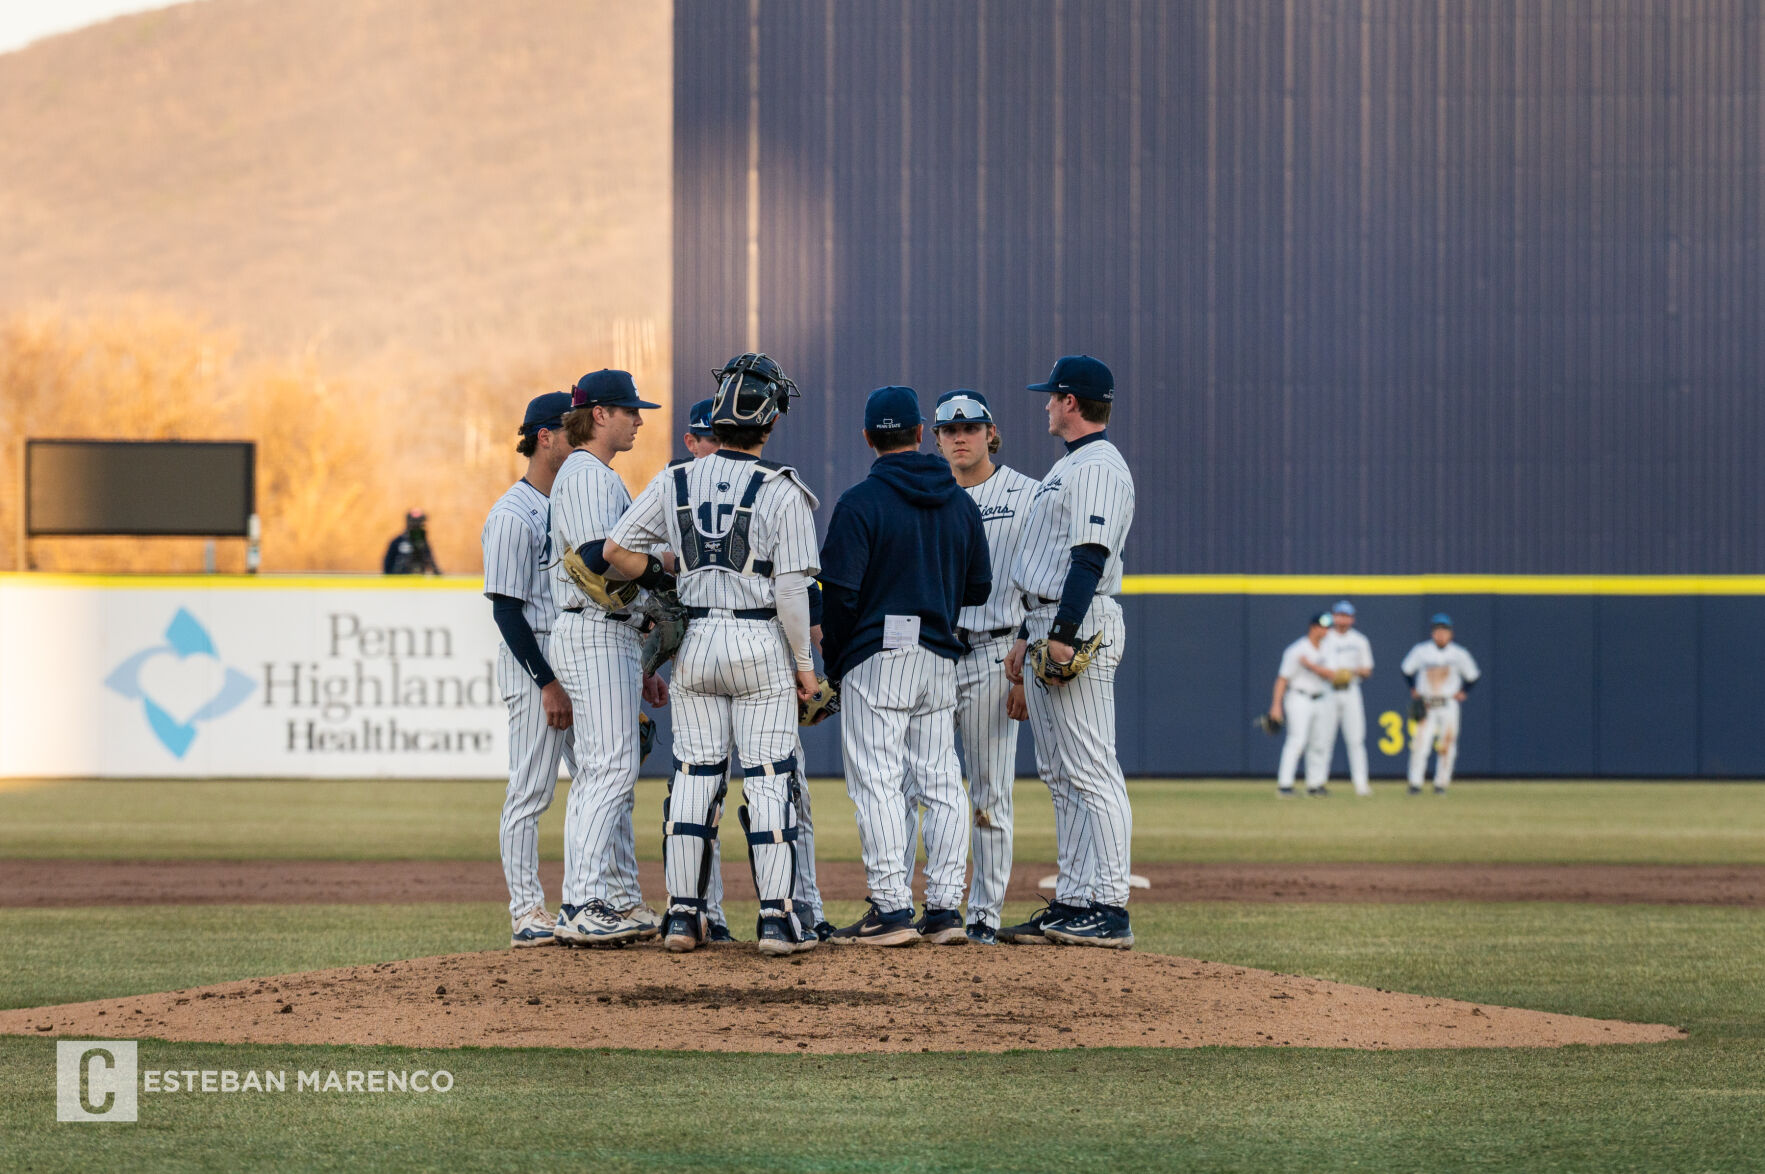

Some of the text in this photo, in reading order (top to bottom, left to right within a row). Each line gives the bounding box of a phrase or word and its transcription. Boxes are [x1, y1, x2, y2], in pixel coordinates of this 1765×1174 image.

[977, 503, 1015, 519] ions
[328, 613, 455, 659] Penn
[261, 660, 505, 723] Highland
[286, 719, 493, 753] Healthcare
